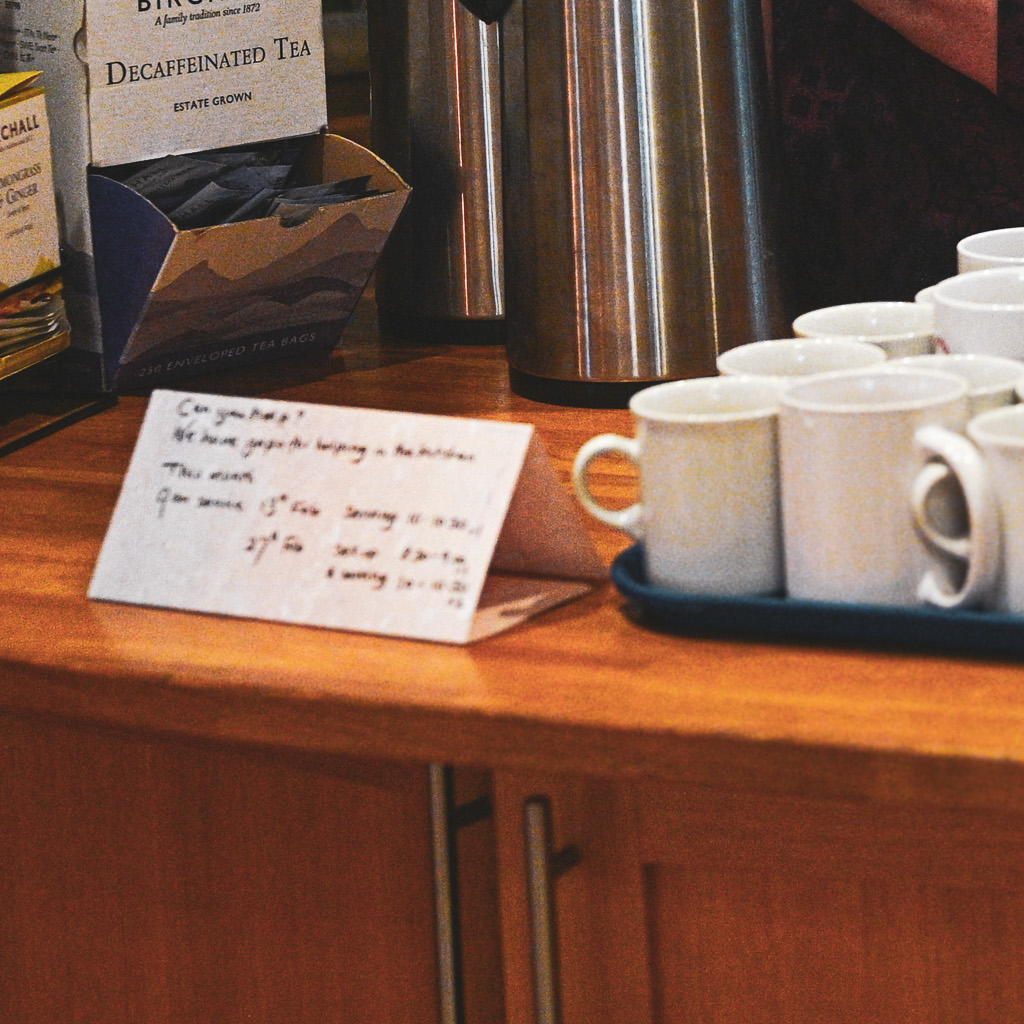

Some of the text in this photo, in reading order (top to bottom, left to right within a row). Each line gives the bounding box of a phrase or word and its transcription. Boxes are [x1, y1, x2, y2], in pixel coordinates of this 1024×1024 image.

[154, 2, 262, 29] A family tradition since 1872
[173, 92, 252, 112] ESTATE GROWN
[165, 345, 246, 372] ENVELOPED
[251, 338, 276, 353] TEA
[280, 331, 317, 347] BAGS
